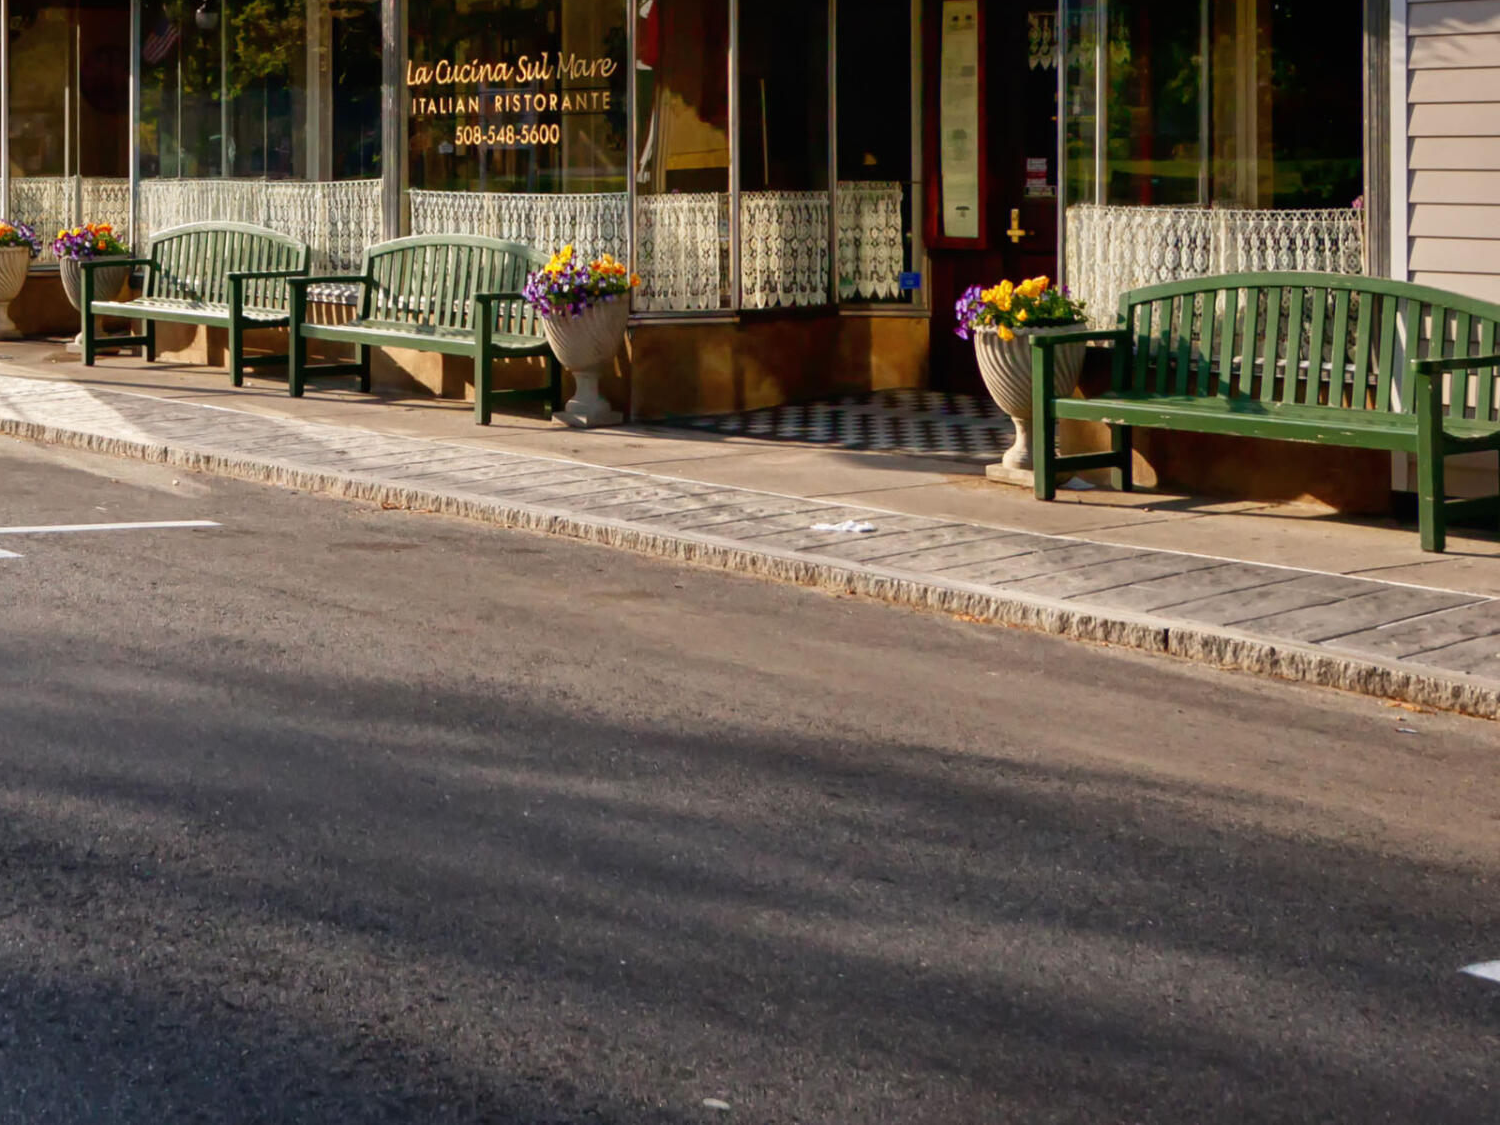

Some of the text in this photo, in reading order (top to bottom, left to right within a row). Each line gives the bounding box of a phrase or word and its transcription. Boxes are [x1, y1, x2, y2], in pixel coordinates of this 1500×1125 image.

[406, 51, 618, 86] La Cucina Sul Mare
[412, 91, 612, 114] ITALIAN RISTORANTE
[454, 123, 560, 145] 508-548-5600
